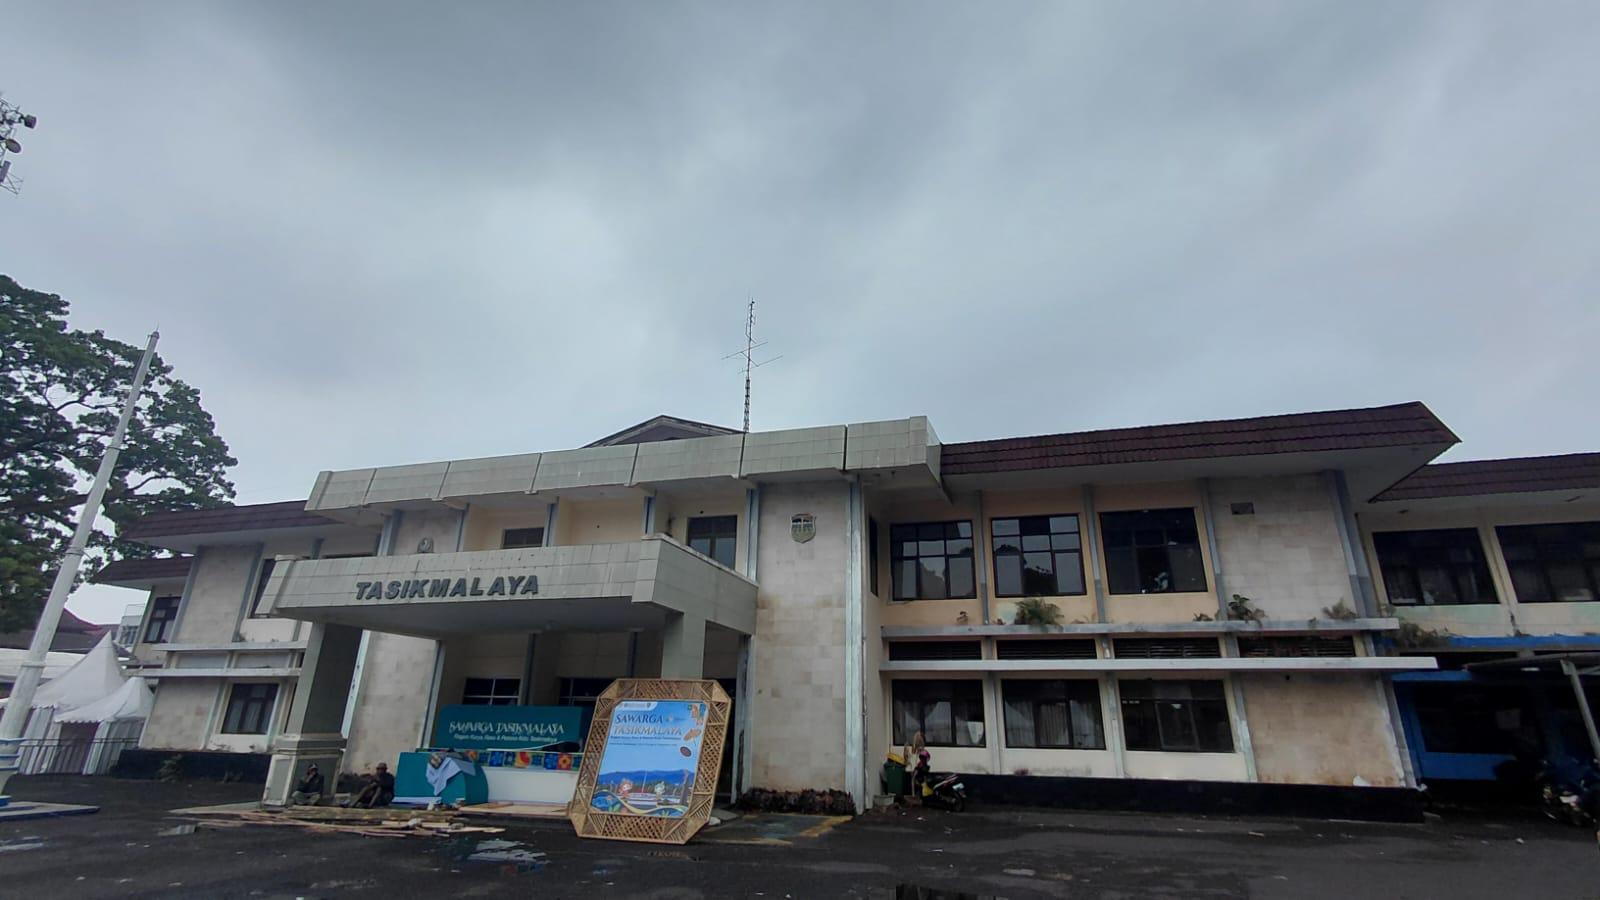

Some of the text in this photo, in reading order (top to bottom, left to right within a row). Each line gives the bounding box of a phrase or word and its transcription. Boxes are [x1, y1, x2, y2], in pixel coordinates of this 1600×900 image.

[356, 575, 539, 600] TASIKMALAYA
[615, 713, 664, 724] SAWARGA
[615, 725, 681, 735] TASIKMALAYA
